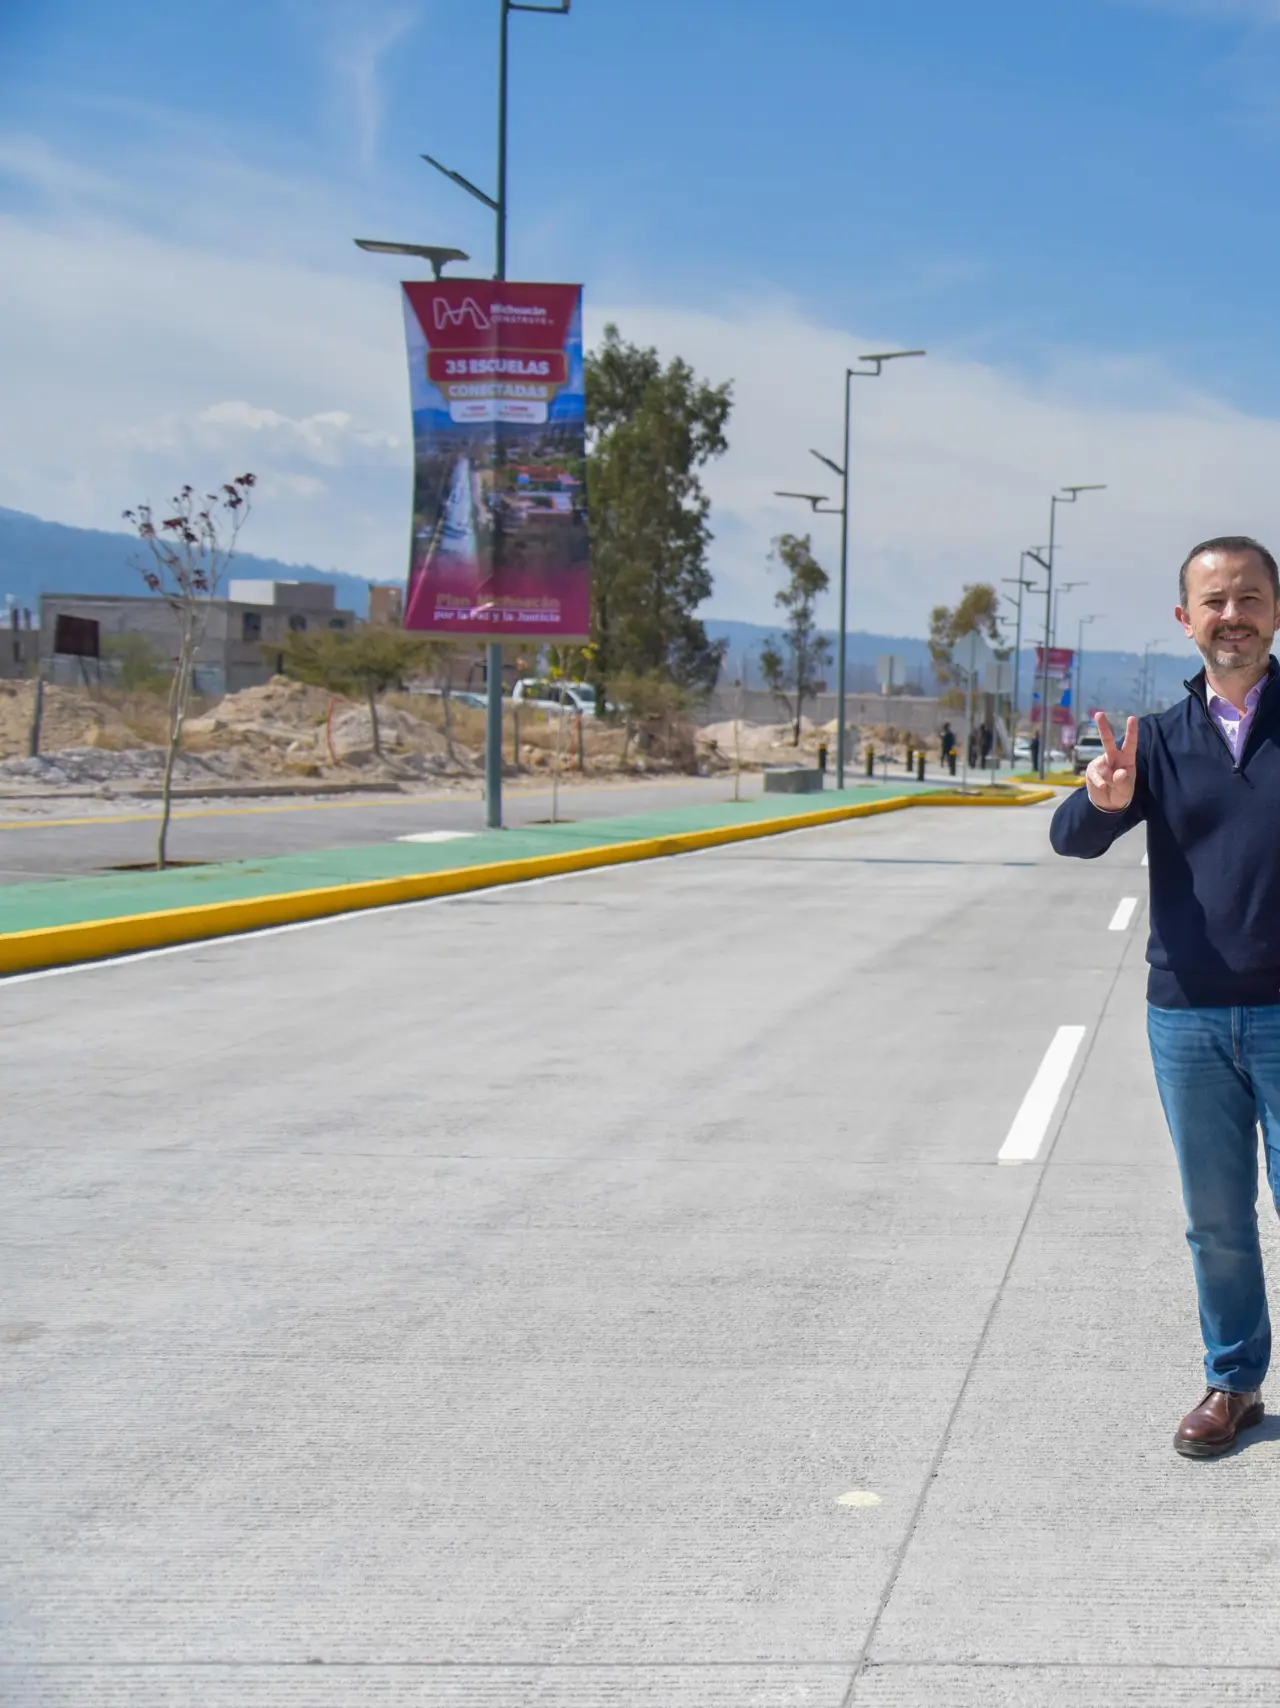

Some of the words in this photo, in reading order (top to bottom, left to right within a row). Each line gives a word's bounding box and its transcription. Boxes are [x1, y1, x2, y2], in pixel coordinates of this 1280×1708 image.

[445, 359, 467, 375] 35
[469, 358, 549, 375] ESCUELAS
[448, 383, 547, 398] CONECTADAS
